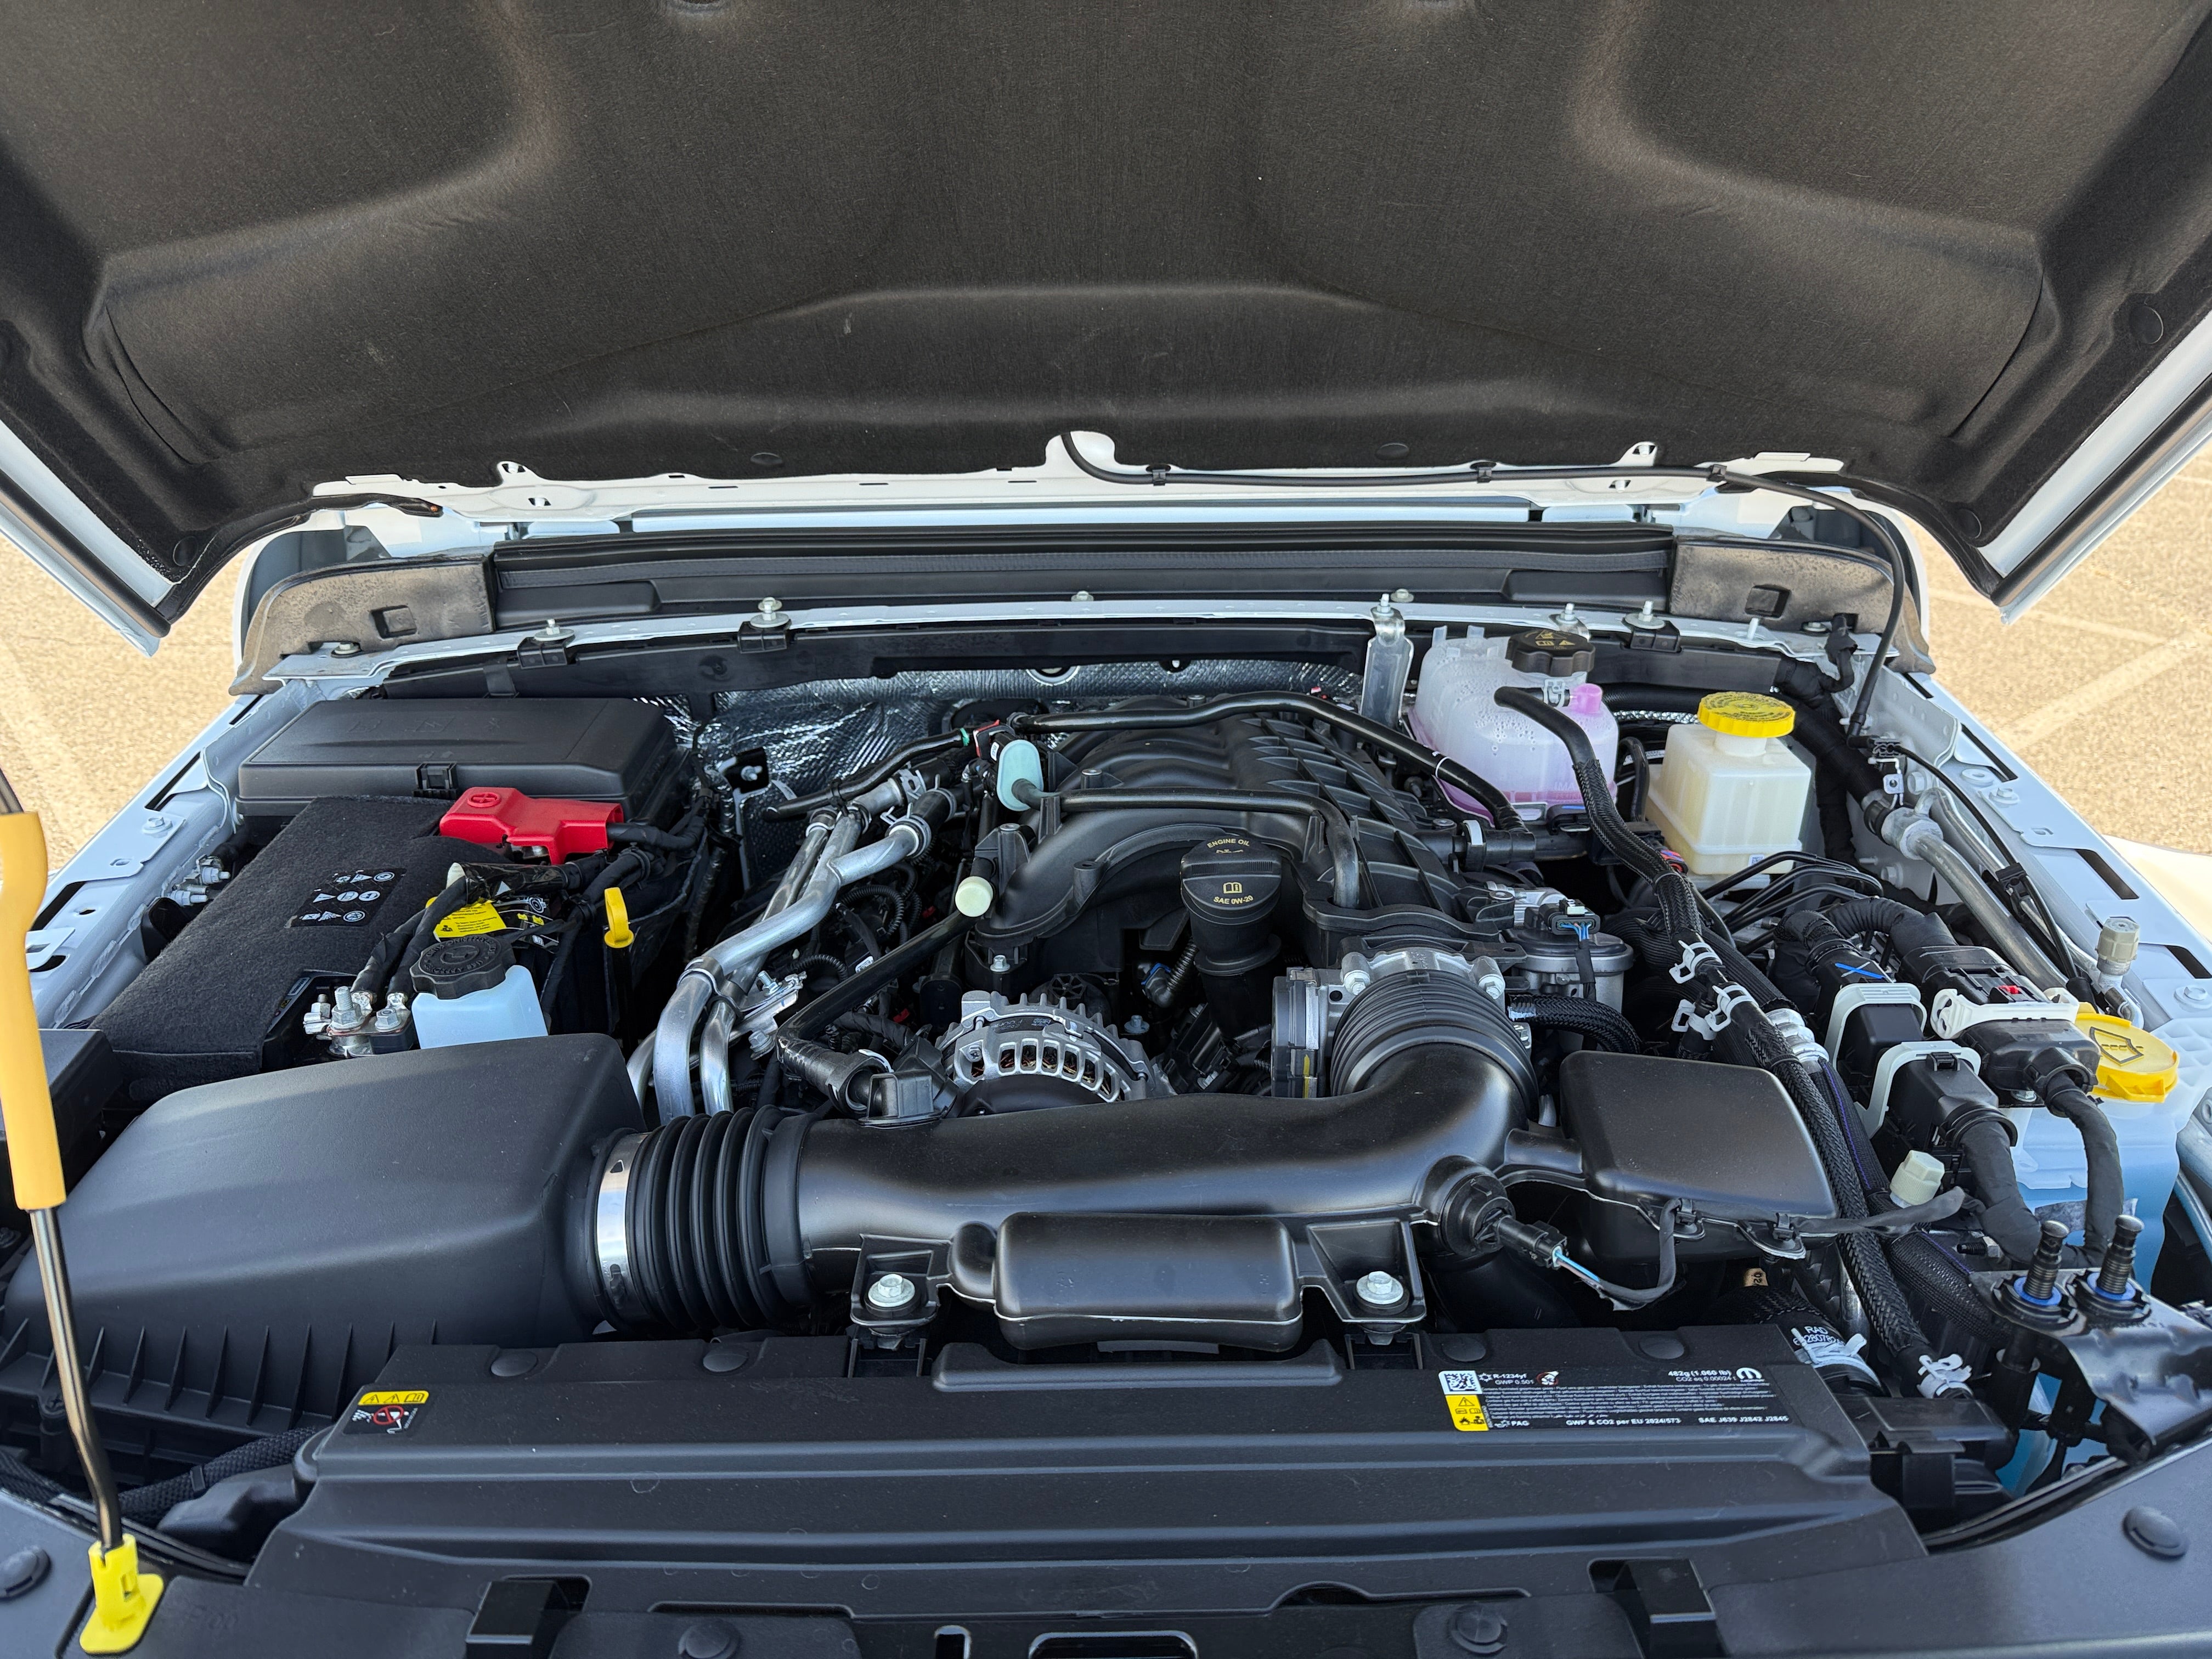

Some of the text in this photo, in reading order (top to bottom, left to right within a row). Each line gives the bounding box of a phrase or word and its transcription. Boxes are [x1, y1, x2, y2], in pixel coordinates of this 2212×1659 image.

[1207, 838, 1236, 848] ENGINE
[1213, 895, 1254, 905] SAE 0W-20
[1804, 1325, 1829, 1335] RAD
